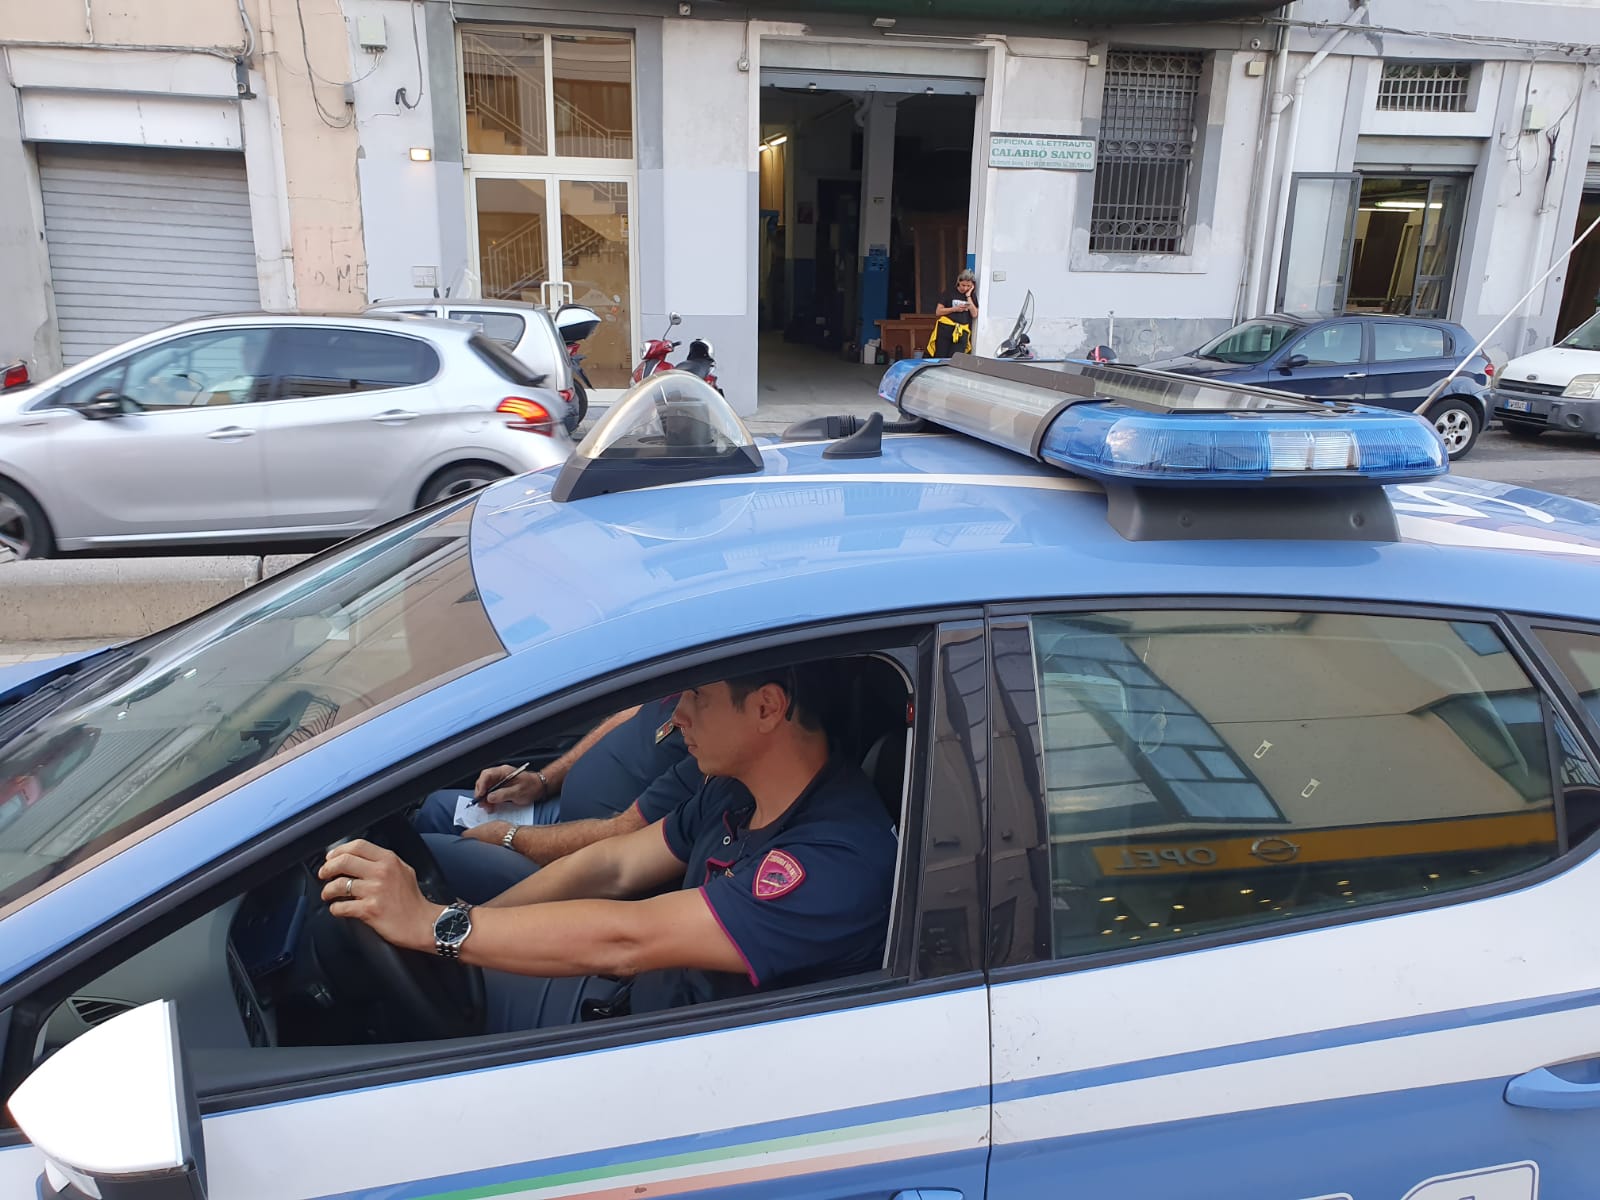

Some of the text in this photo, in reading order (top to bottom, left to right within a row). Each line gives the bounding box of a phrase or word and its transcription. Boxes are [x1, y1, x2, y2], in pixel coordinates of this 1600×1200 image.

[992, 138, 1093, 148] OFFICINA ELETTRAUTO
[1050, 150, 1092, 160] SANTO
